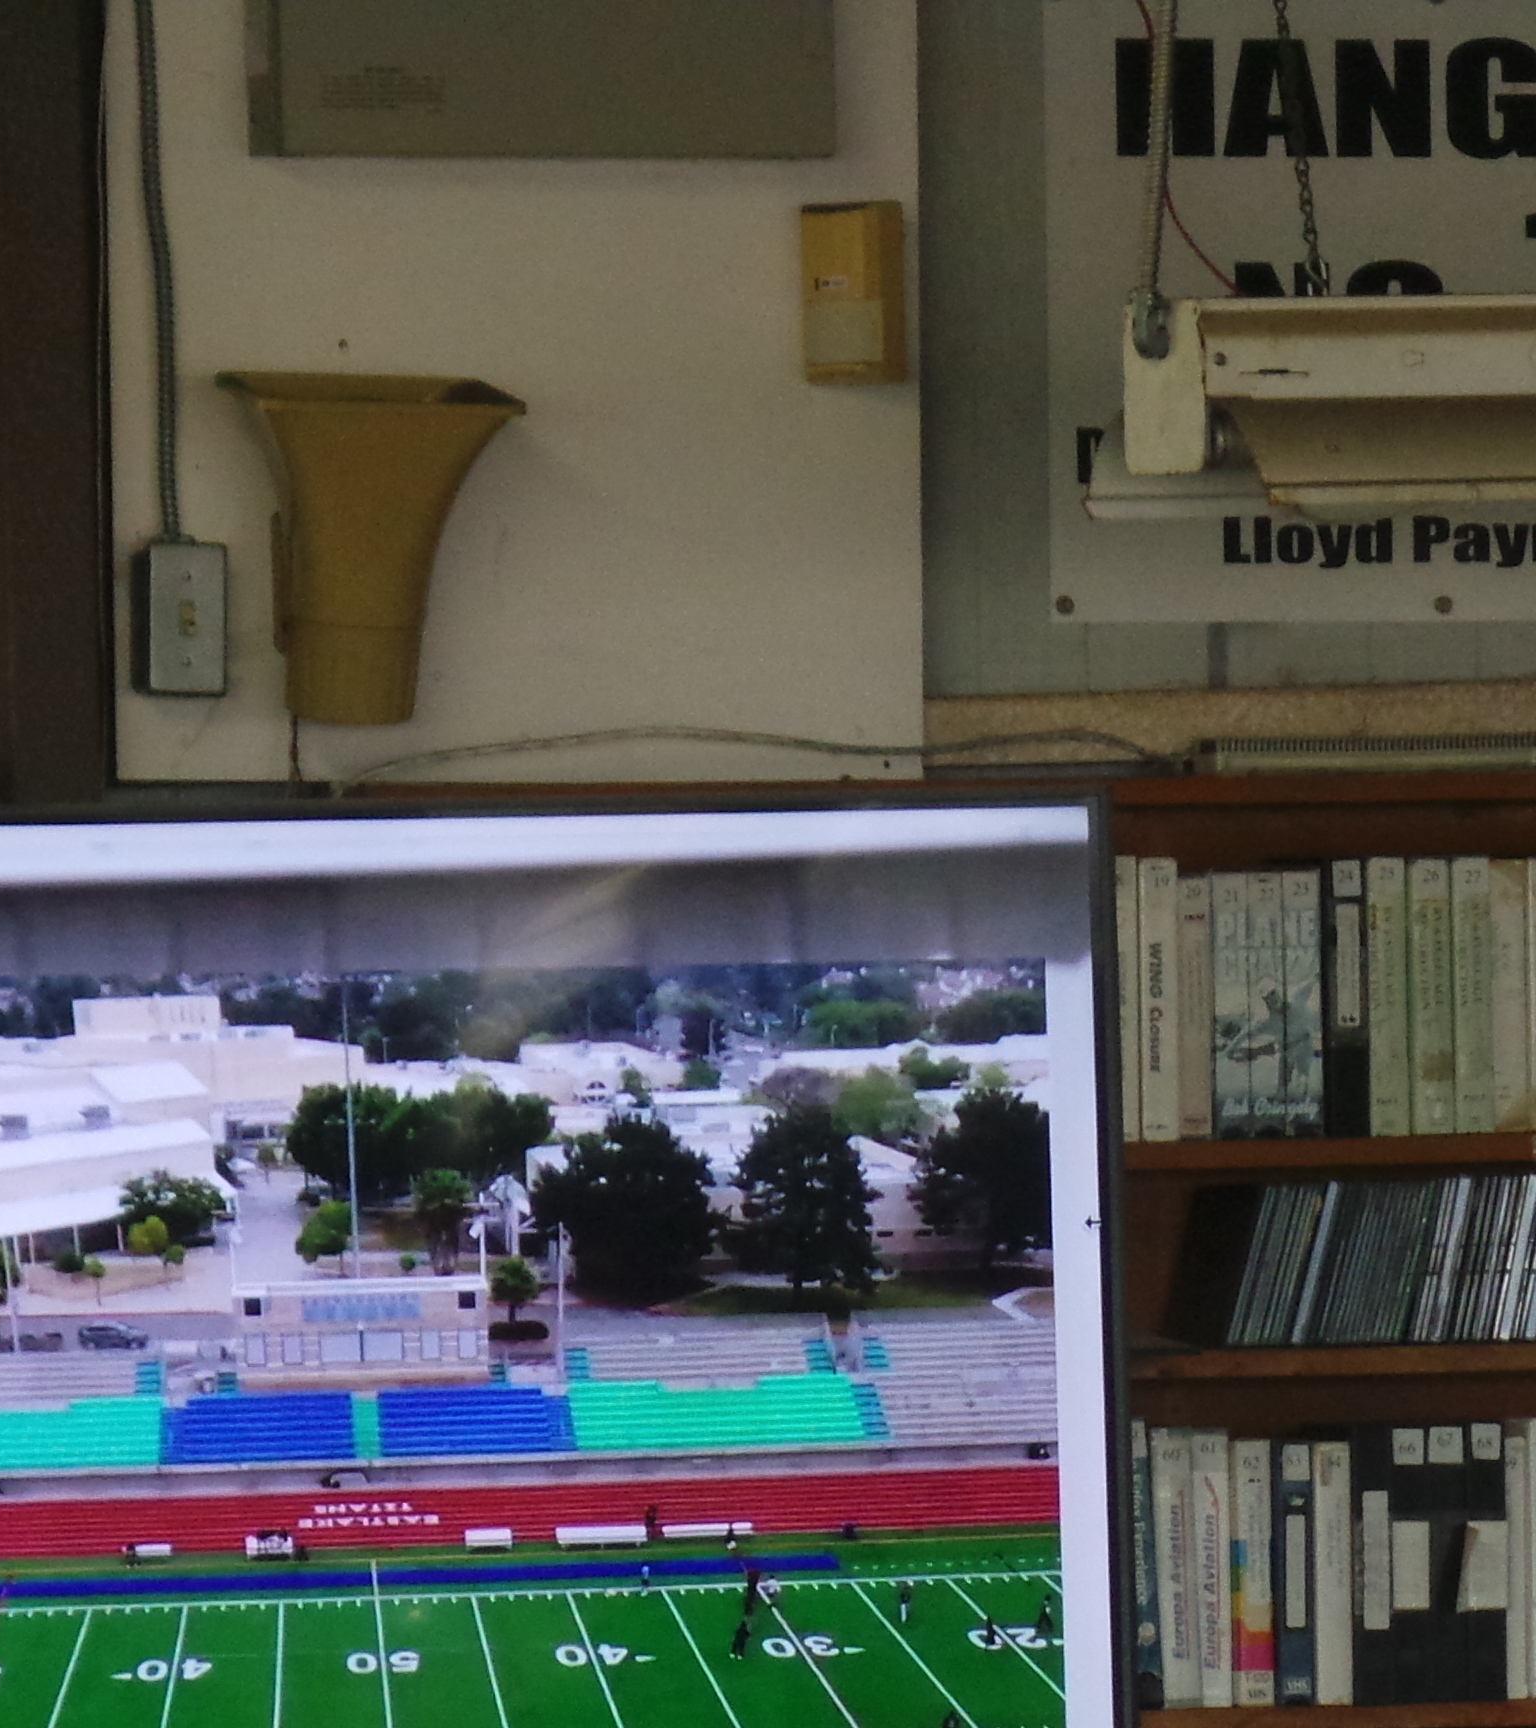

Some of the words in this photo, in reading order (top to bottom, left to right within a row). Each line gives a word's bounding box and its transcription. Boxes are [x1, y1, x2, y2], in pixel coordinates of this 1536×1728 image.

[1222, 515, 1394, 568] Lloyd
[1148, 942, 1163, 999] WING
[1168, 1503, 1183, 1584] Aviation
[1202, 1513, 1216, 1595] Aviation
[761, 1635, 836, 1659] 30
[1171, 1591, 1186, 1660] Europa
[1202, 1600, 1218, 1670] Europa
[136, 1657, 213, 1681] 40
[346, 1650, 422, 1676] 50
[554, 1643, 629, 1668] 40
[1285, 1680, 1308, 1691] VHS
